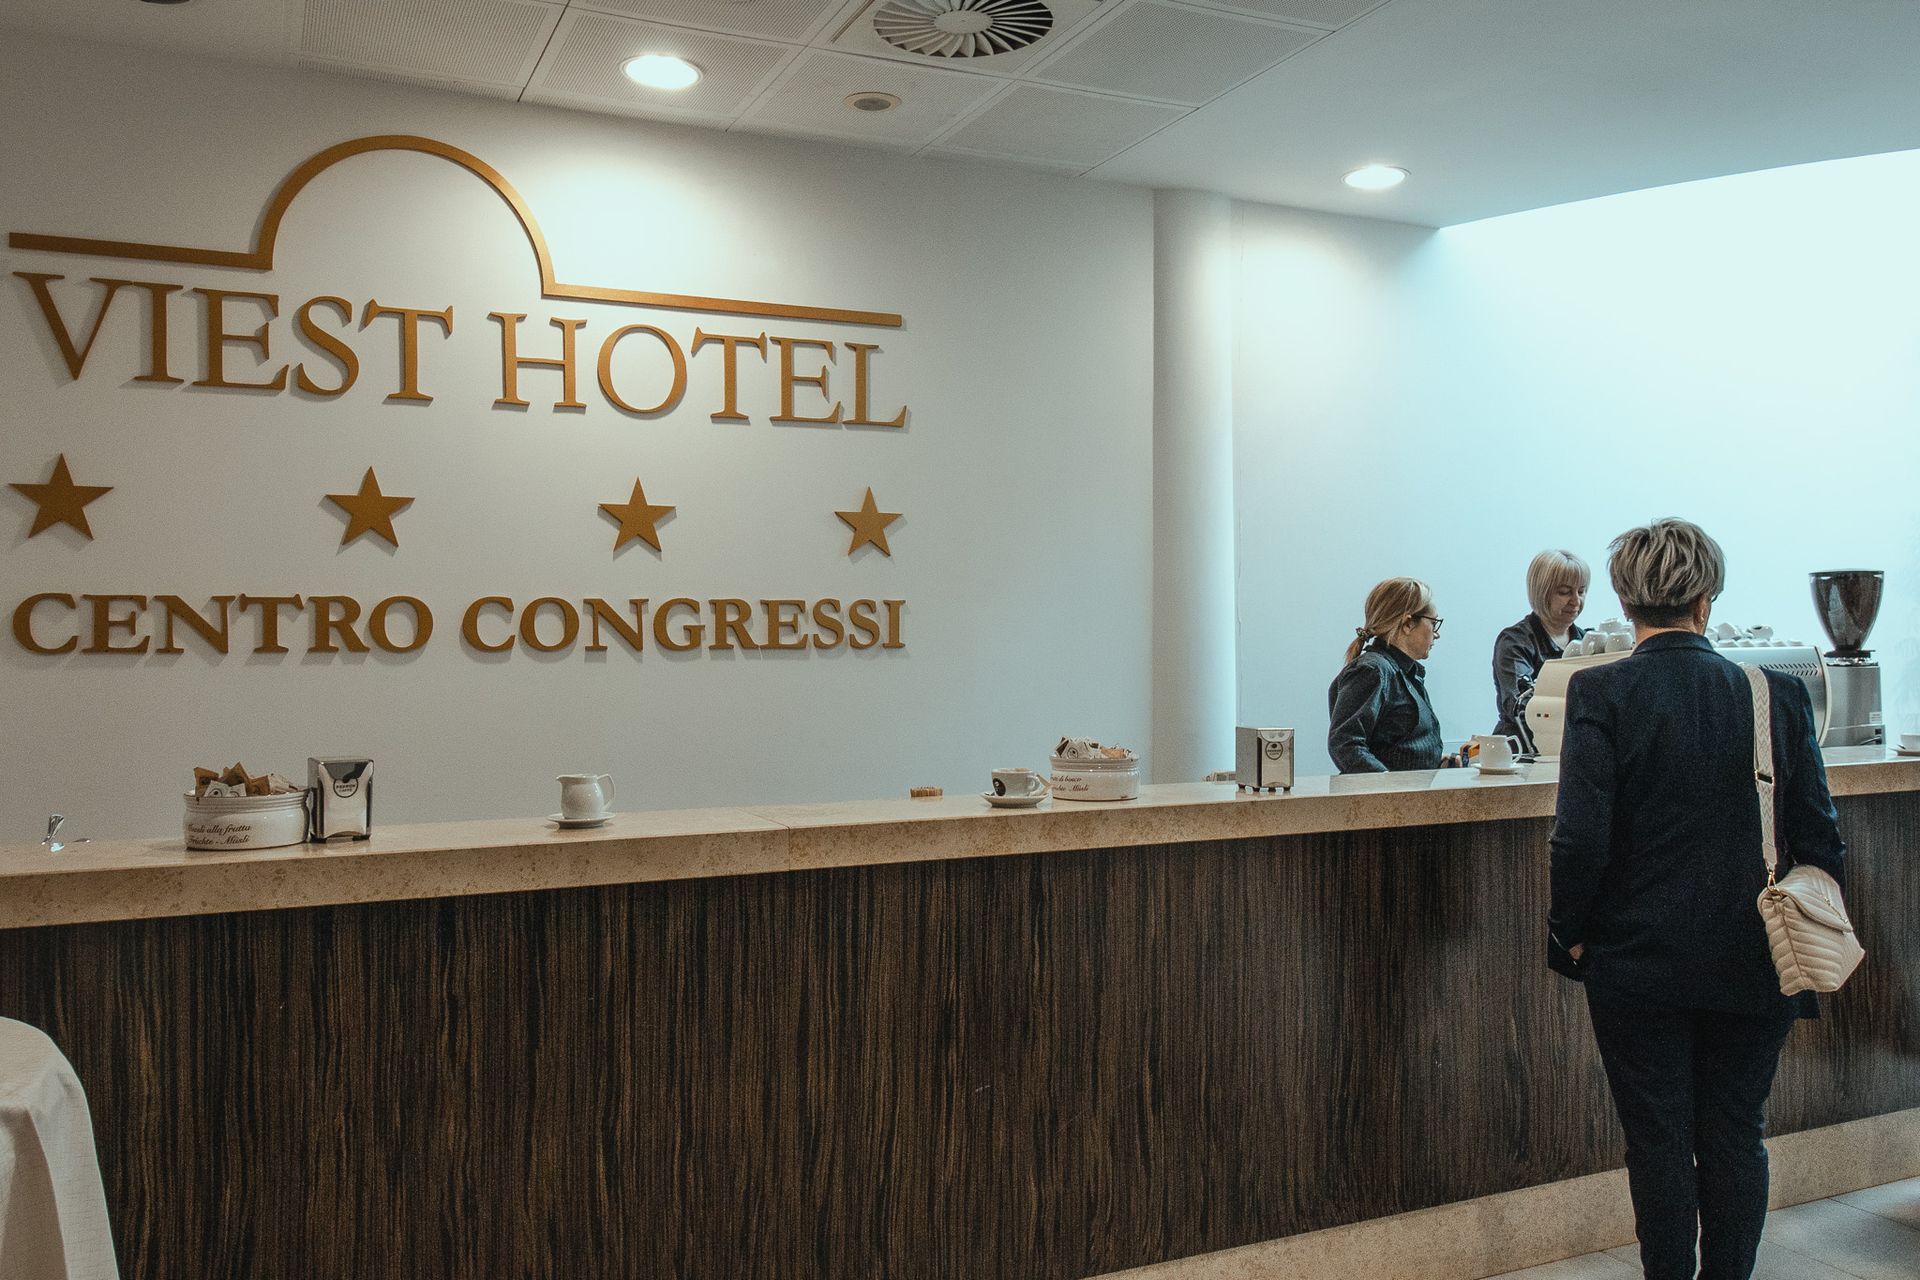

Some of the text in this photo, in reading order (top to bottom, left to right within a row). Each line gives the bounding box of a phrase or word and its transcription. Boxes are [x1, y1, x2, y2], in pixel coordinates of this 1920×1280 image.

[12, 270, 907, 428] VIEST HOTEL
[12, 592, 906, 655] CENTRO CONGRESSI
